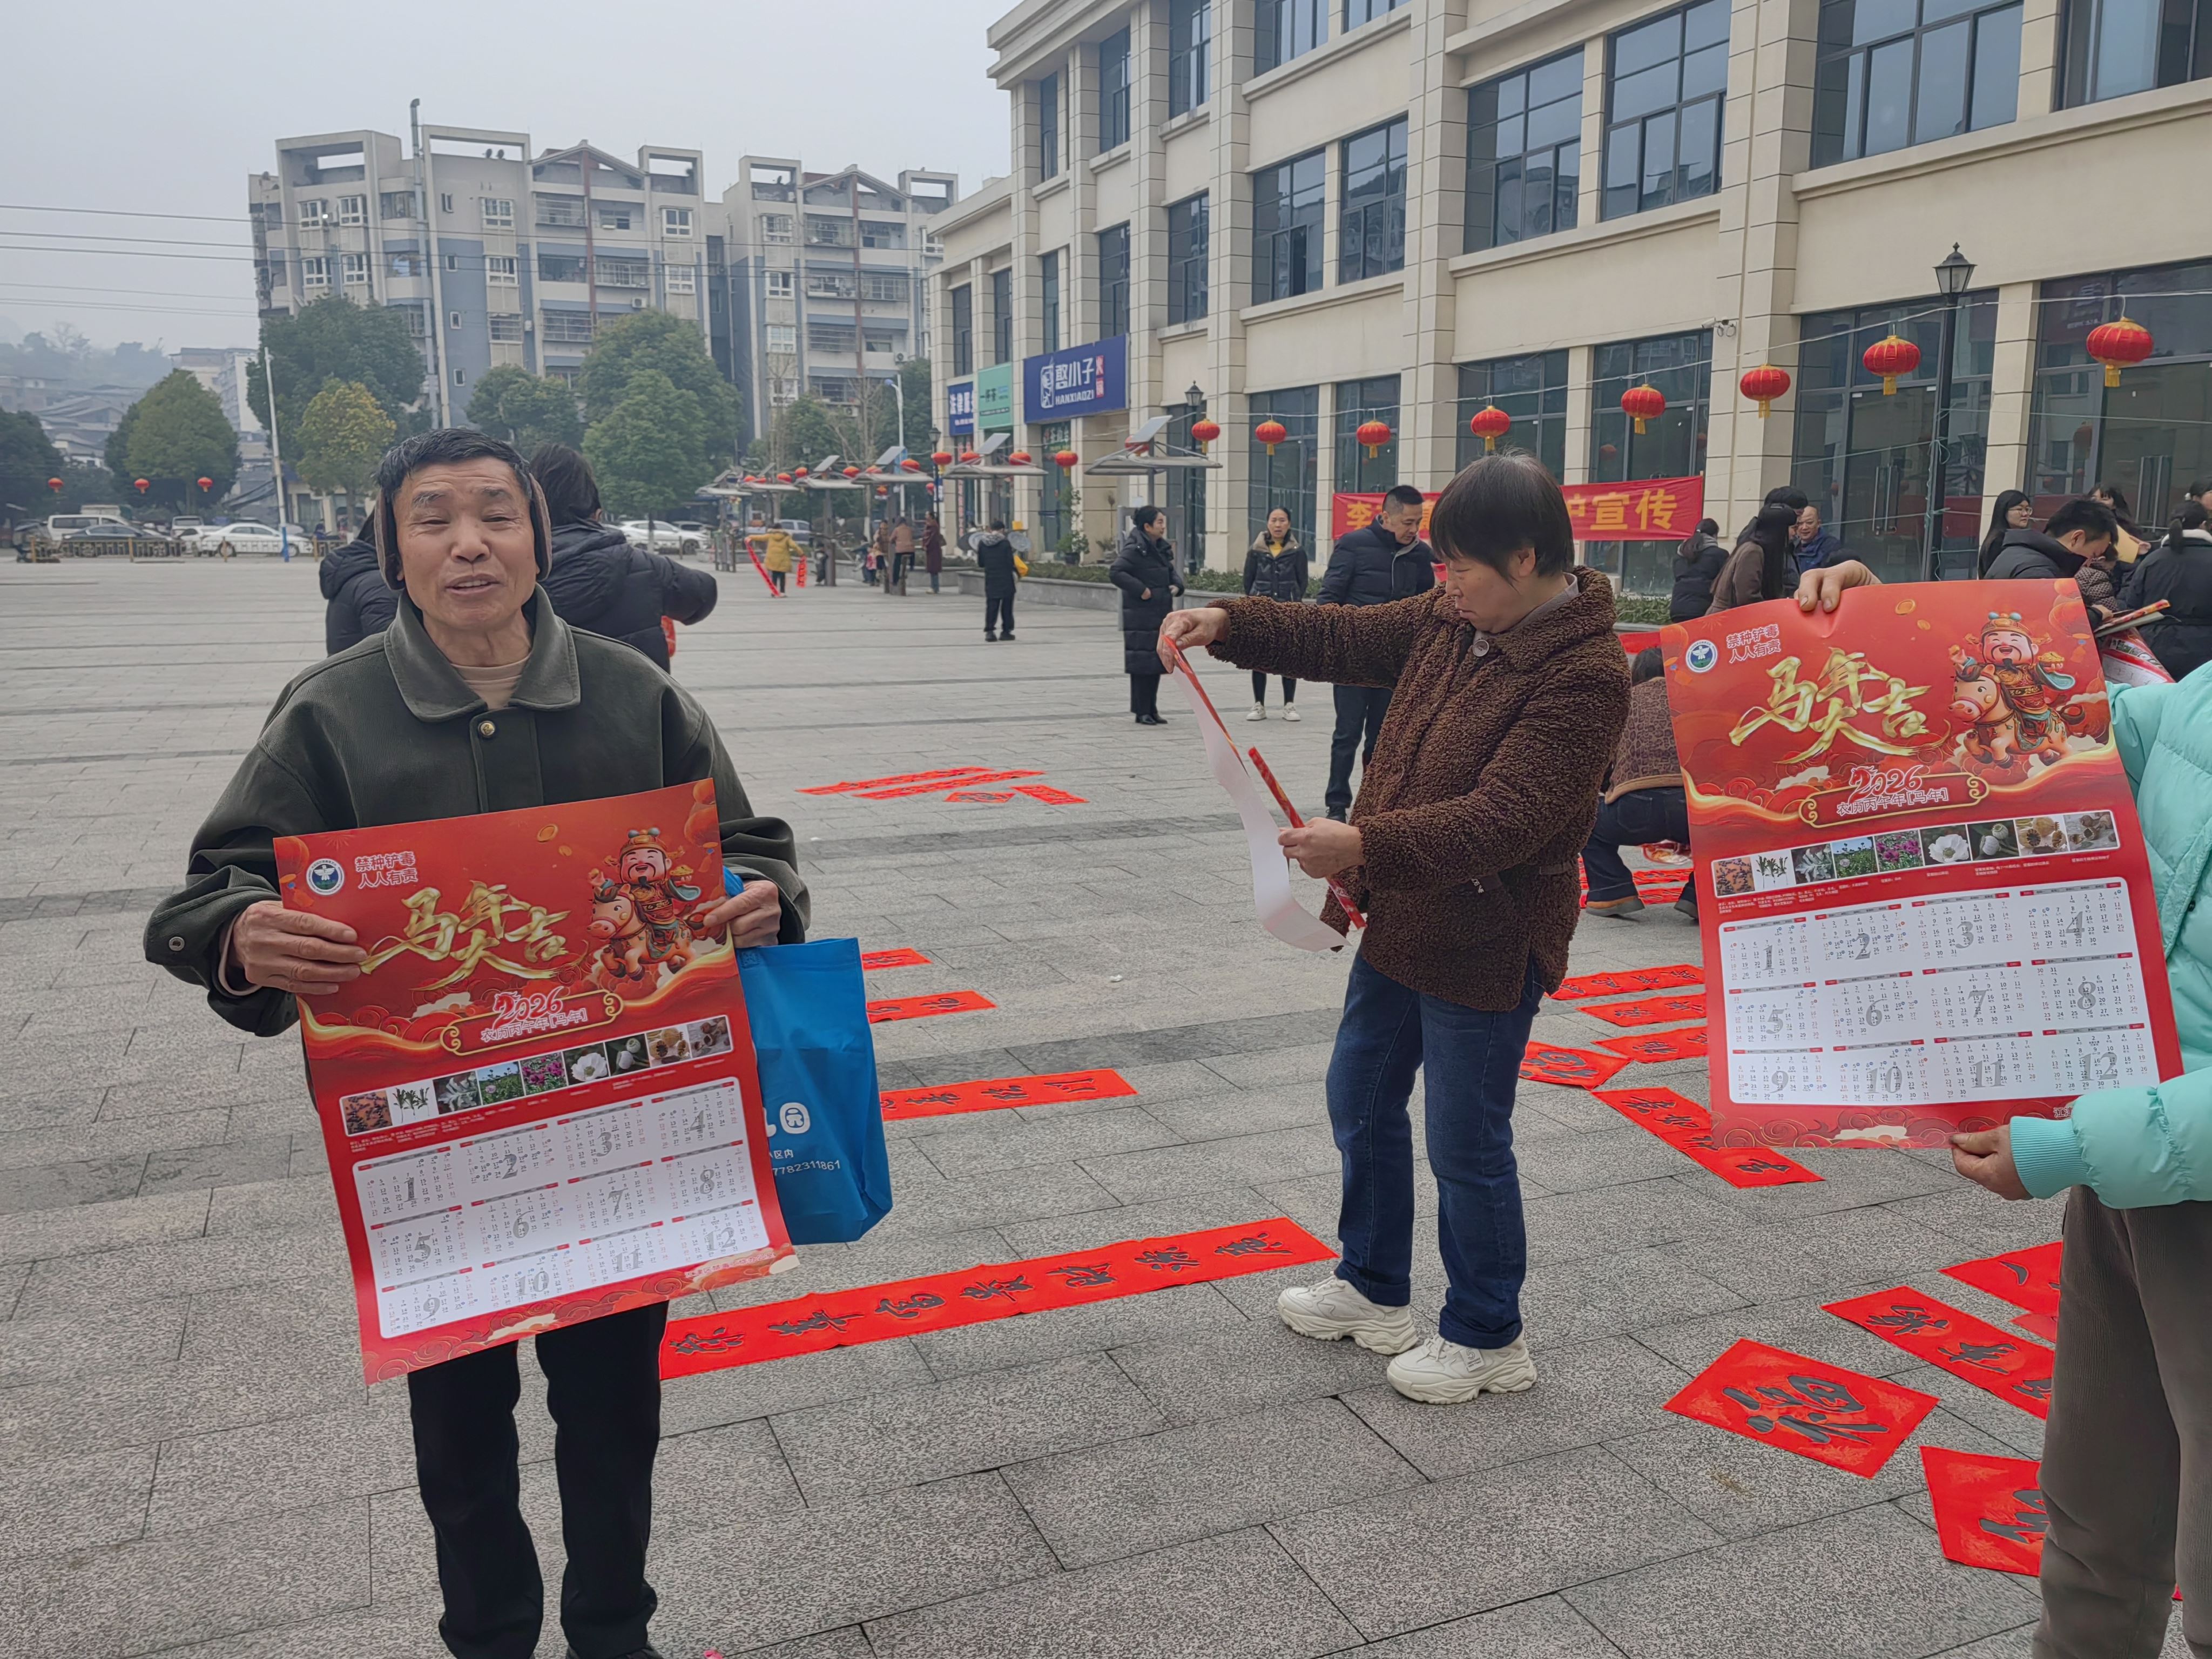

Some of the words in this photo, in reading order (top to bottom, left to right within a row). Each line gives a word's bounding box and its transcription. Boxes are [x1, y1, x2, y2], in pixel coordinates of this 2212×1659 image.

[1055, 389, 1095, 406] HANXIAOZI
[1726, 624, 1779, 648] 禁种铲毒
[1729, 638, 1782, 664] 人人有责
[1847, 765, 1924, 802] 2026
[354, 851, 415, 873] 禁种铲毒
[358, 867, 419, 889] 人人有责
[1955, 921, 1974, 948] 3
[2066, 911, 2085, 939] 4
[1762, 945, 1775, 970] 1
[1854, 933, 1871, 960] 2
[492, 986, 564, 1028] 2026
[1967, 990, 1987, 1018] 7
[2078, 981, 2096, 1009] 8
[1766, 1009, 1785, 1034] 5
[1866, 999, 1885, 1026] 6
[1971, 1060, 2005, 1088] 11
[2079, 1051, 2117, 1081] 12
[1770, 1070, 1789, 1093] 9
[1864, 1068, 1903, 1094] 10
[690, 1110, 705, 1135] 4
[596, 1132, 612, 1157] 3
[769, 1149, 794, 1159] 区内
[502, 1154, 518, 1179] 2
[772, 1160, 841, 1176] 7782311861
[404, 1177, 418, 1203] 1
[700, 1169, 714, 1195] 8
[608, 1188, 628, 1216] 7
[513, 1211, 534, 1238] 6
[415, 1235, 431, 1263] 5
[704, 1227, 735, 1252] 12
[613, 1249, 640, 1274] 11
[515, 1271, 549, 1296] 10
[422, 1297, 440, 1320] 9
[1722, 1375, 1889, 1445] 福
